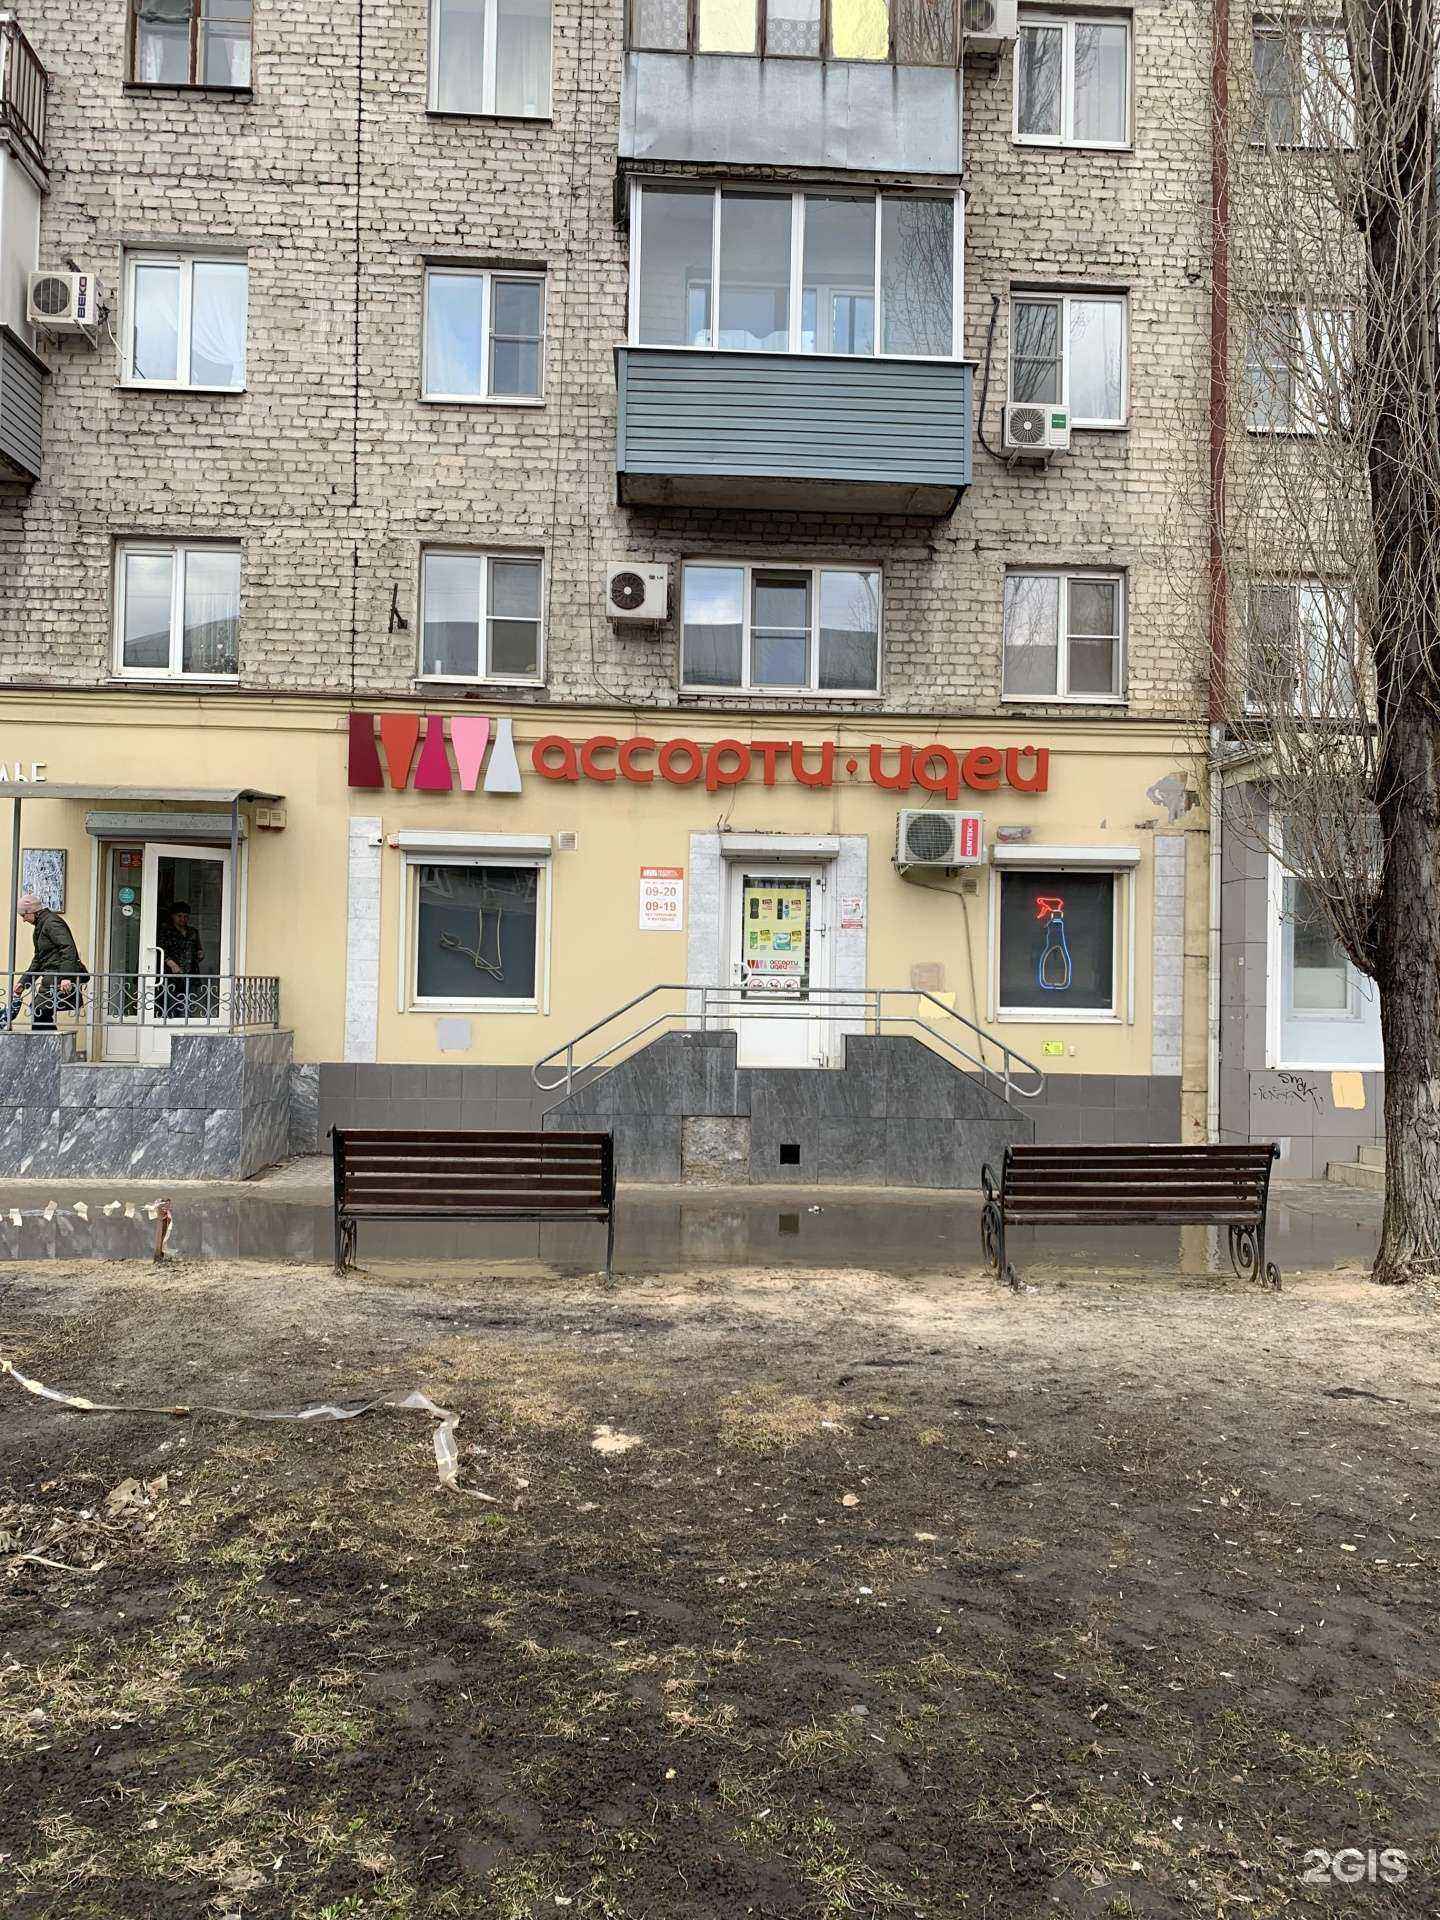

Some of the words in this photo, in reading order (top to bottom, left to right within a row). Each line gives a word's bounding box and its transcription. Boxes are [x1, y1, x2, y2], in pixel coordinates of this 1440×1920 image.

[869, 744, 1050, 801] идей
[645, 886, 677, 897] 09-20
[645, 901, 677, 911] 09-19
